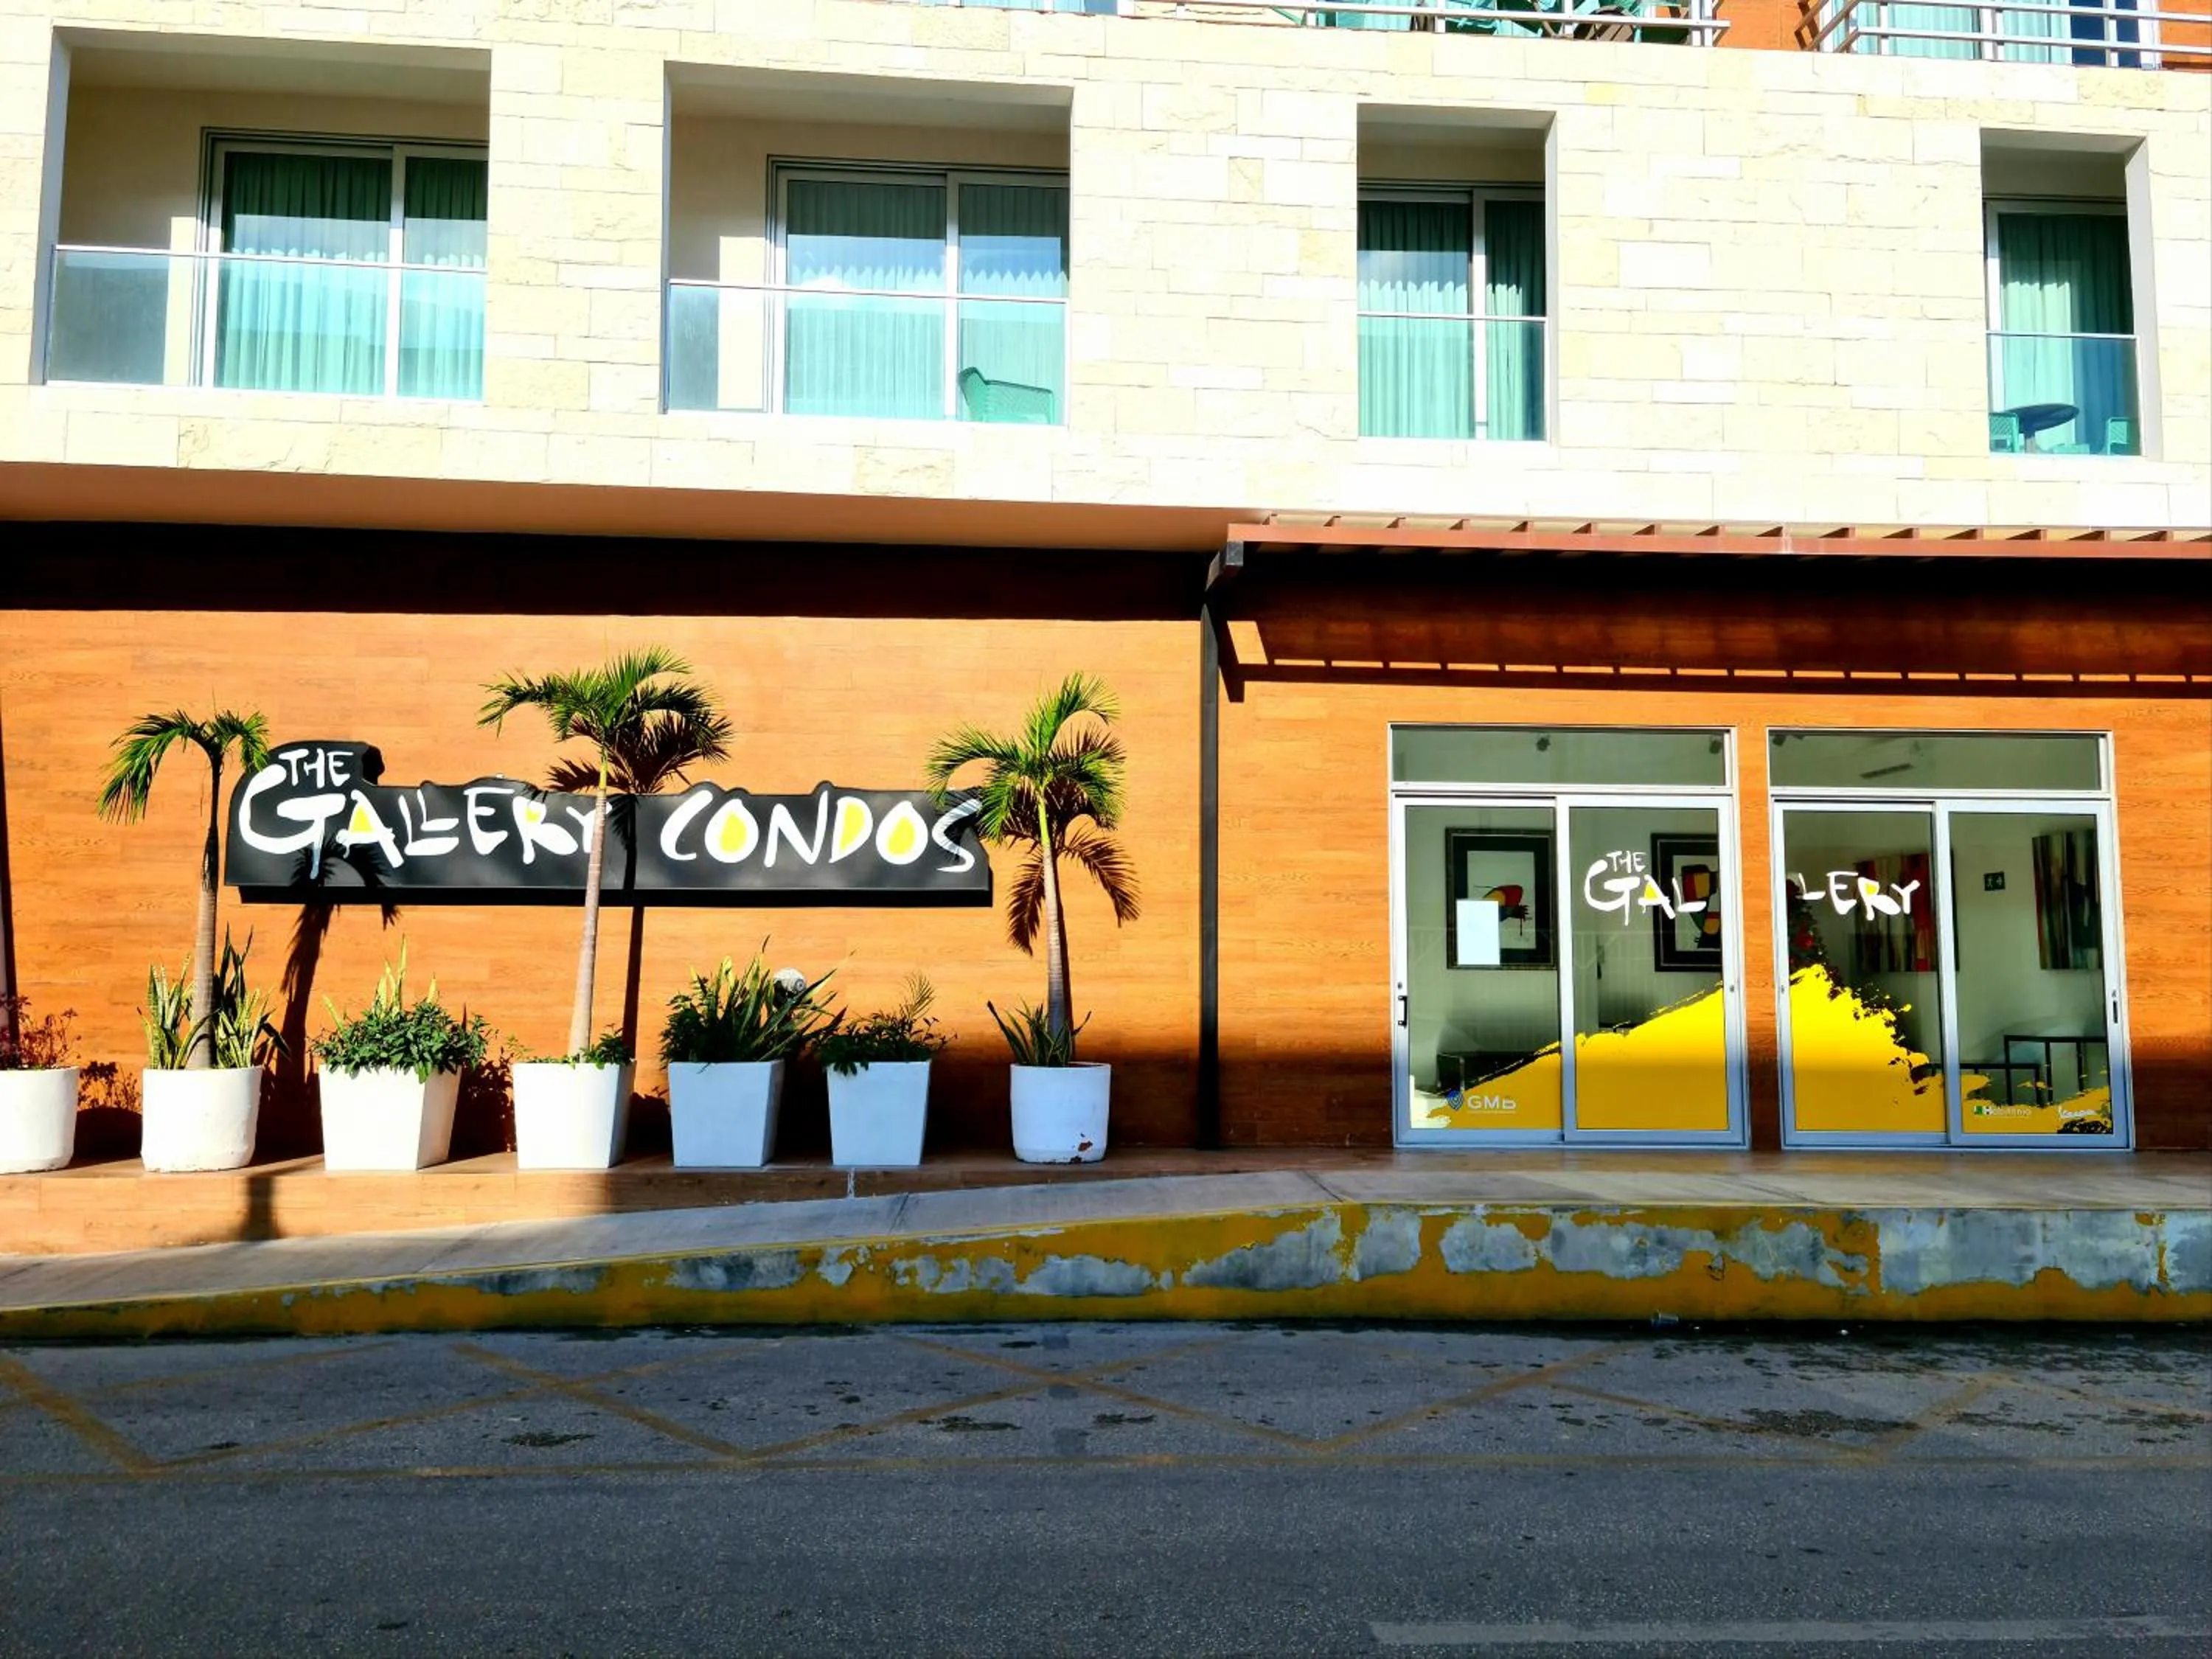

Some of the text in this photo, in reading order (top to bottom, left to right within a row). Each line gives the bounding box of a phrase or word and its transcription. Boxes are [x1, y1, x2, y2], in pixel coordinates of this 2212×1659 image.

[278, 748, 352, 788] THE
[659, 790, 982, 872] CONDOS
[1607, 851, 1646, 872] THE
[1584, 860, 1707, 925] GAL
